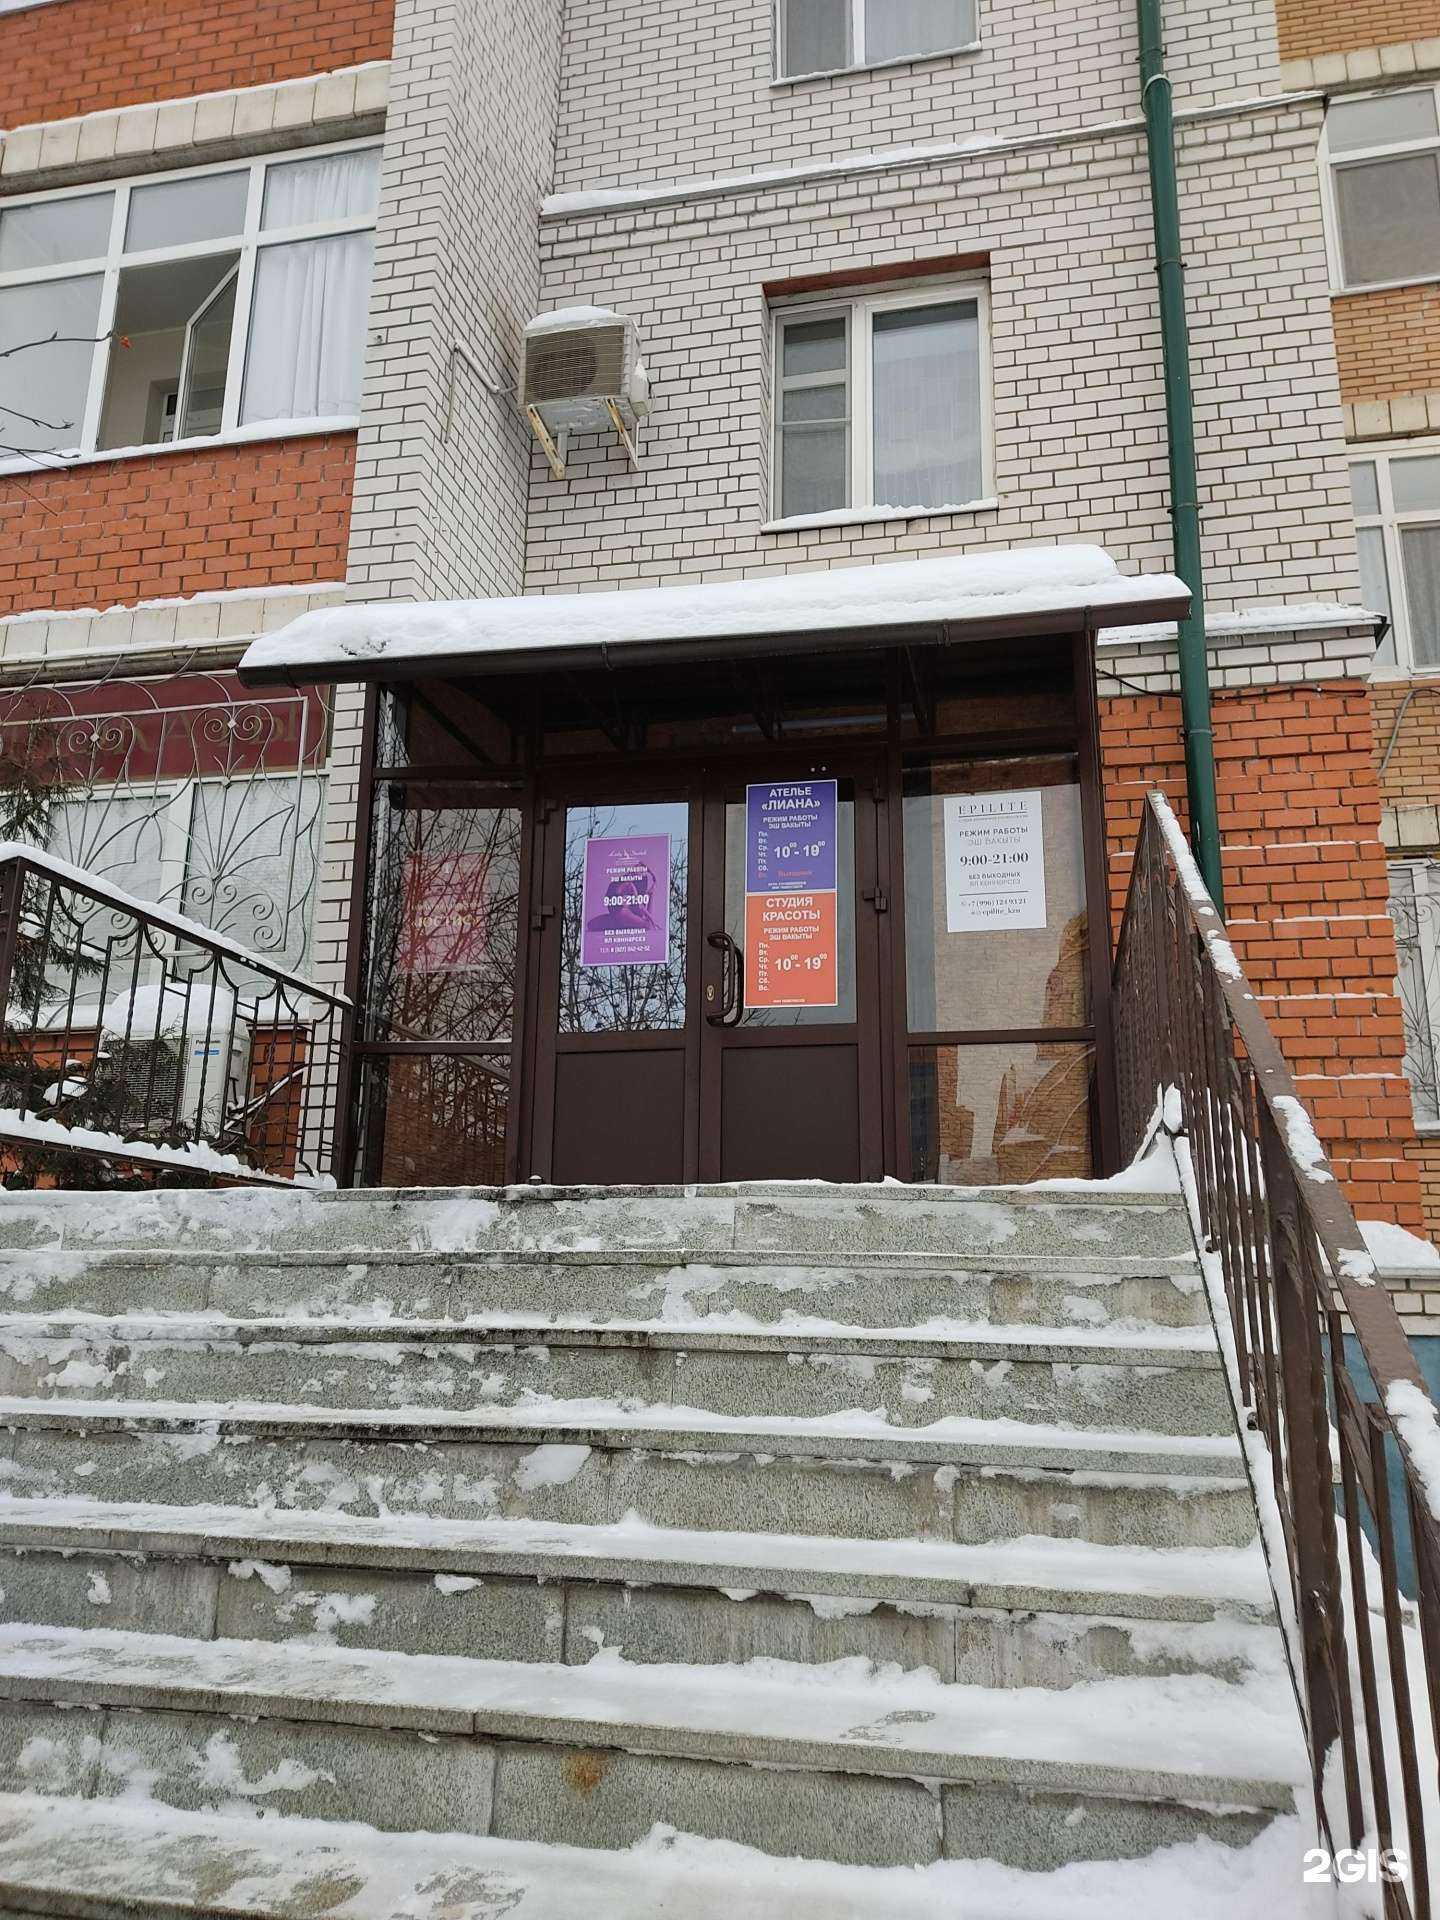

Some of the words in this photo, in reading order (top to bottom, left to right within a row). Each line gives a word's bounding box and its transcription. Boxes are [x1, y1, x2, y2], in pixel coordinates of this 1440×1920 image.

[769, 786, 812, 797] АТЕЛЬЕ
[761, 798, 821, 810] «ЛИАНА»
[959, 801, 1028, 814] EPILITE
[788, 814, 818, 822] РАБОТЫ
[781, 821, 811, 829] ВАКЫТЫ
[959, 829, 990, 838] РЕЖИМ
[993, 826, 1028, 835] РАБОТЫ
[960, 852, 1029, 866] 9:00-21:00
[603, 894, 649, 906] 9:00-21:00
[766, 896, 813, 908] СТУДИЯ
[762, 909, 821, 922] КРАСОТЫ
[789, 925, 819, 933] РАБОТЫ
